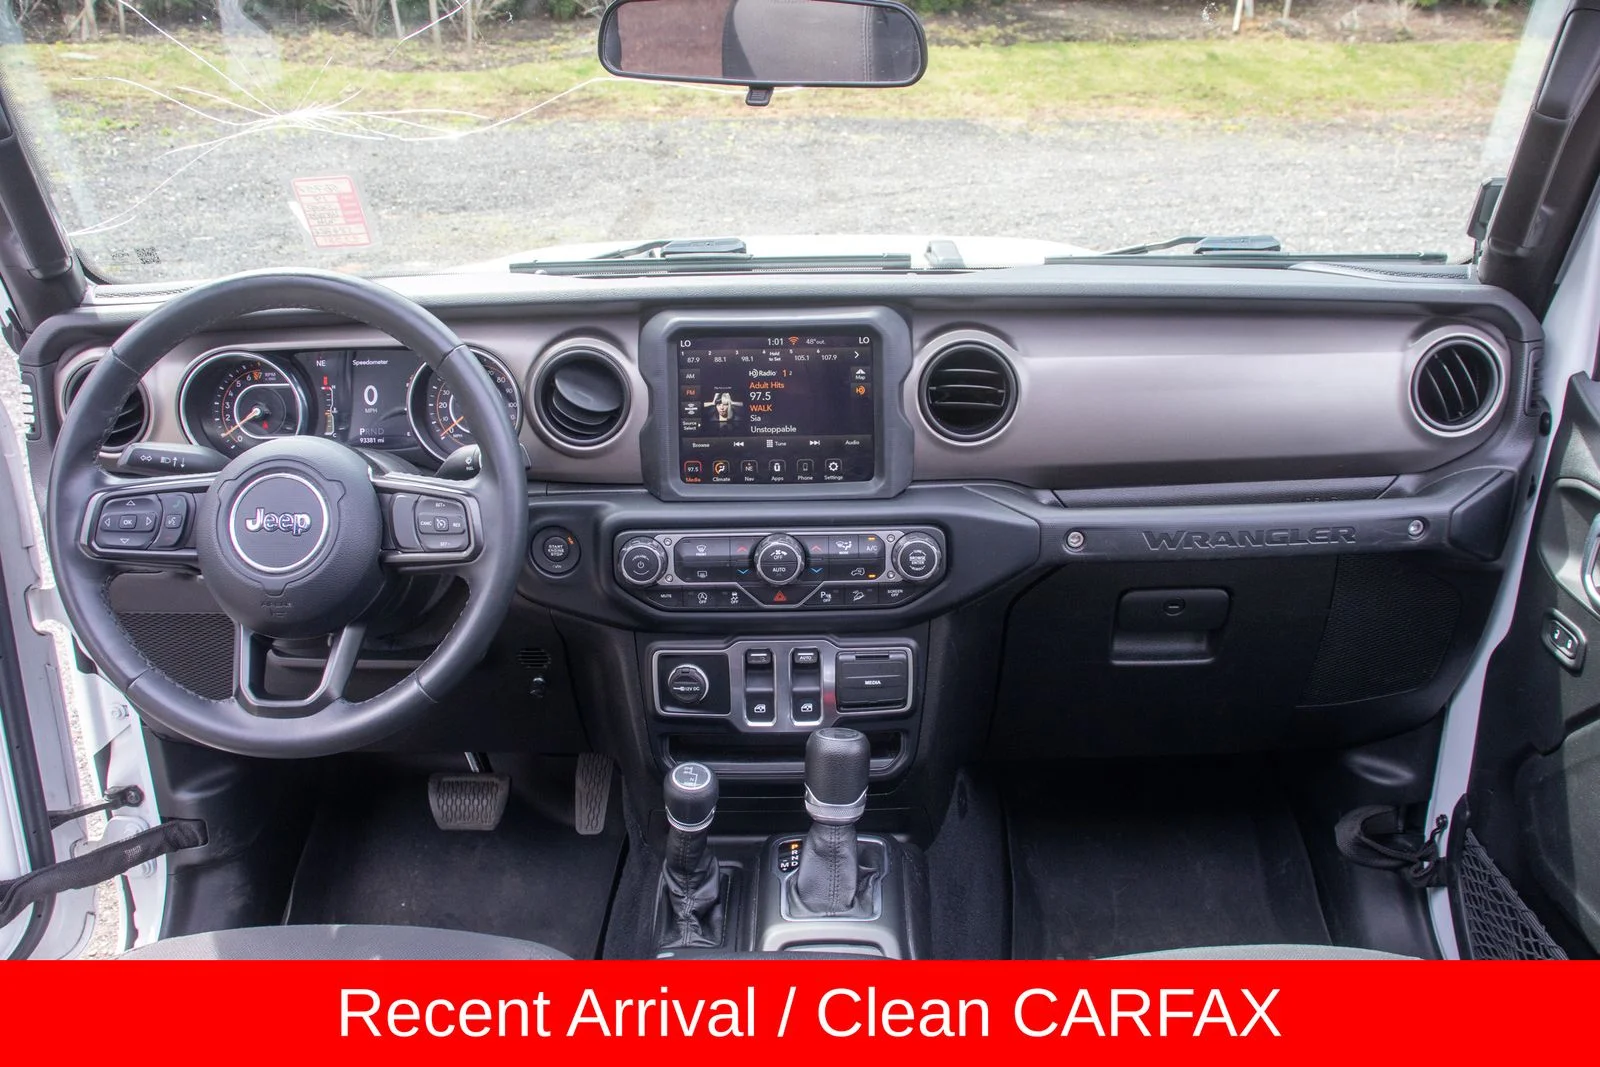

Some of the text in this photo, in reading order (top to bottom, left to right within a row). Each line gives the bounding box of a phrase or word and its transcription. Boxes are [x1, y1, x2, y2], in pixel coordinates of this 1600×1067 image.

[680, 340, 692, 348] LO
[767, 337, 784, 346] 1:01
[858, 336, 870, 344] LO
[364, 384, 378, 406] 0
[750, 392, 772, 401] 97.5
[750, 404, 773, 412] WALK
[750, 426, 797, 434] Unstoppable
[246, 508, 311, 536] Jeep
[1141, 526, 1357, 551] WRANGLER
